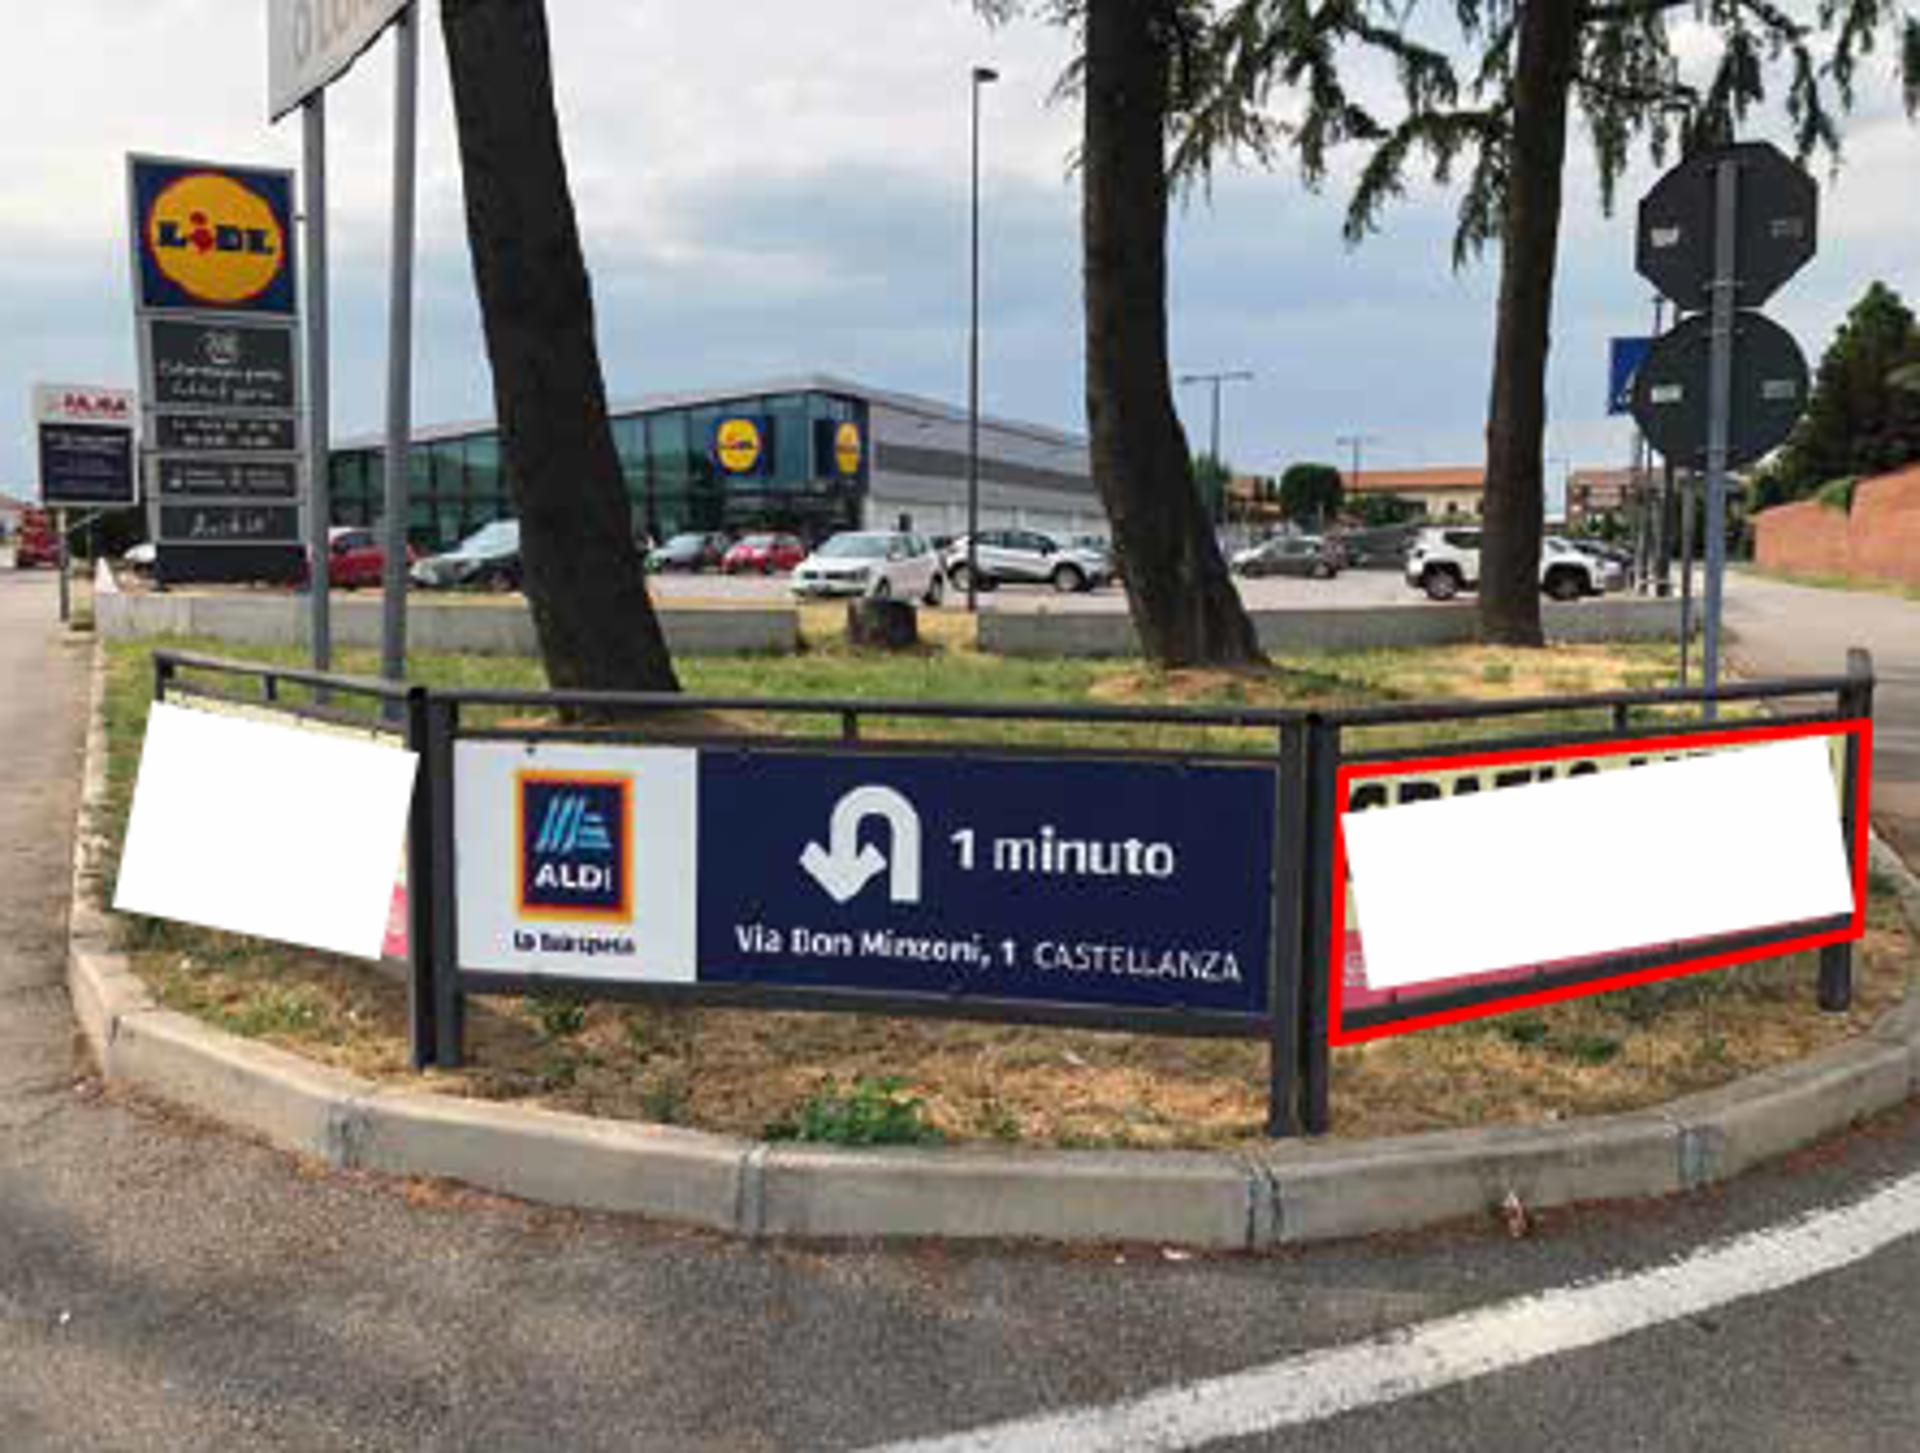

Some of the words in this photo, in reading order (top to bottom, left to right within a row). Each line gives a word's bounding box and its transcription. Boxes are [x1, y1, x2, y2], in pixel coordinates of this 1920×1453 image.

[534, 863, 612, 892] ALDI
[950, 828, 975, 871] 1
[994, 824, 1174, 878] minuto
[734, 923, 783, 954] Via
[791, 925, 854, 957] Don
[1002, 938, 1017, 968] 1
[1033, 941, 1244, 985] CASTELLANZA
